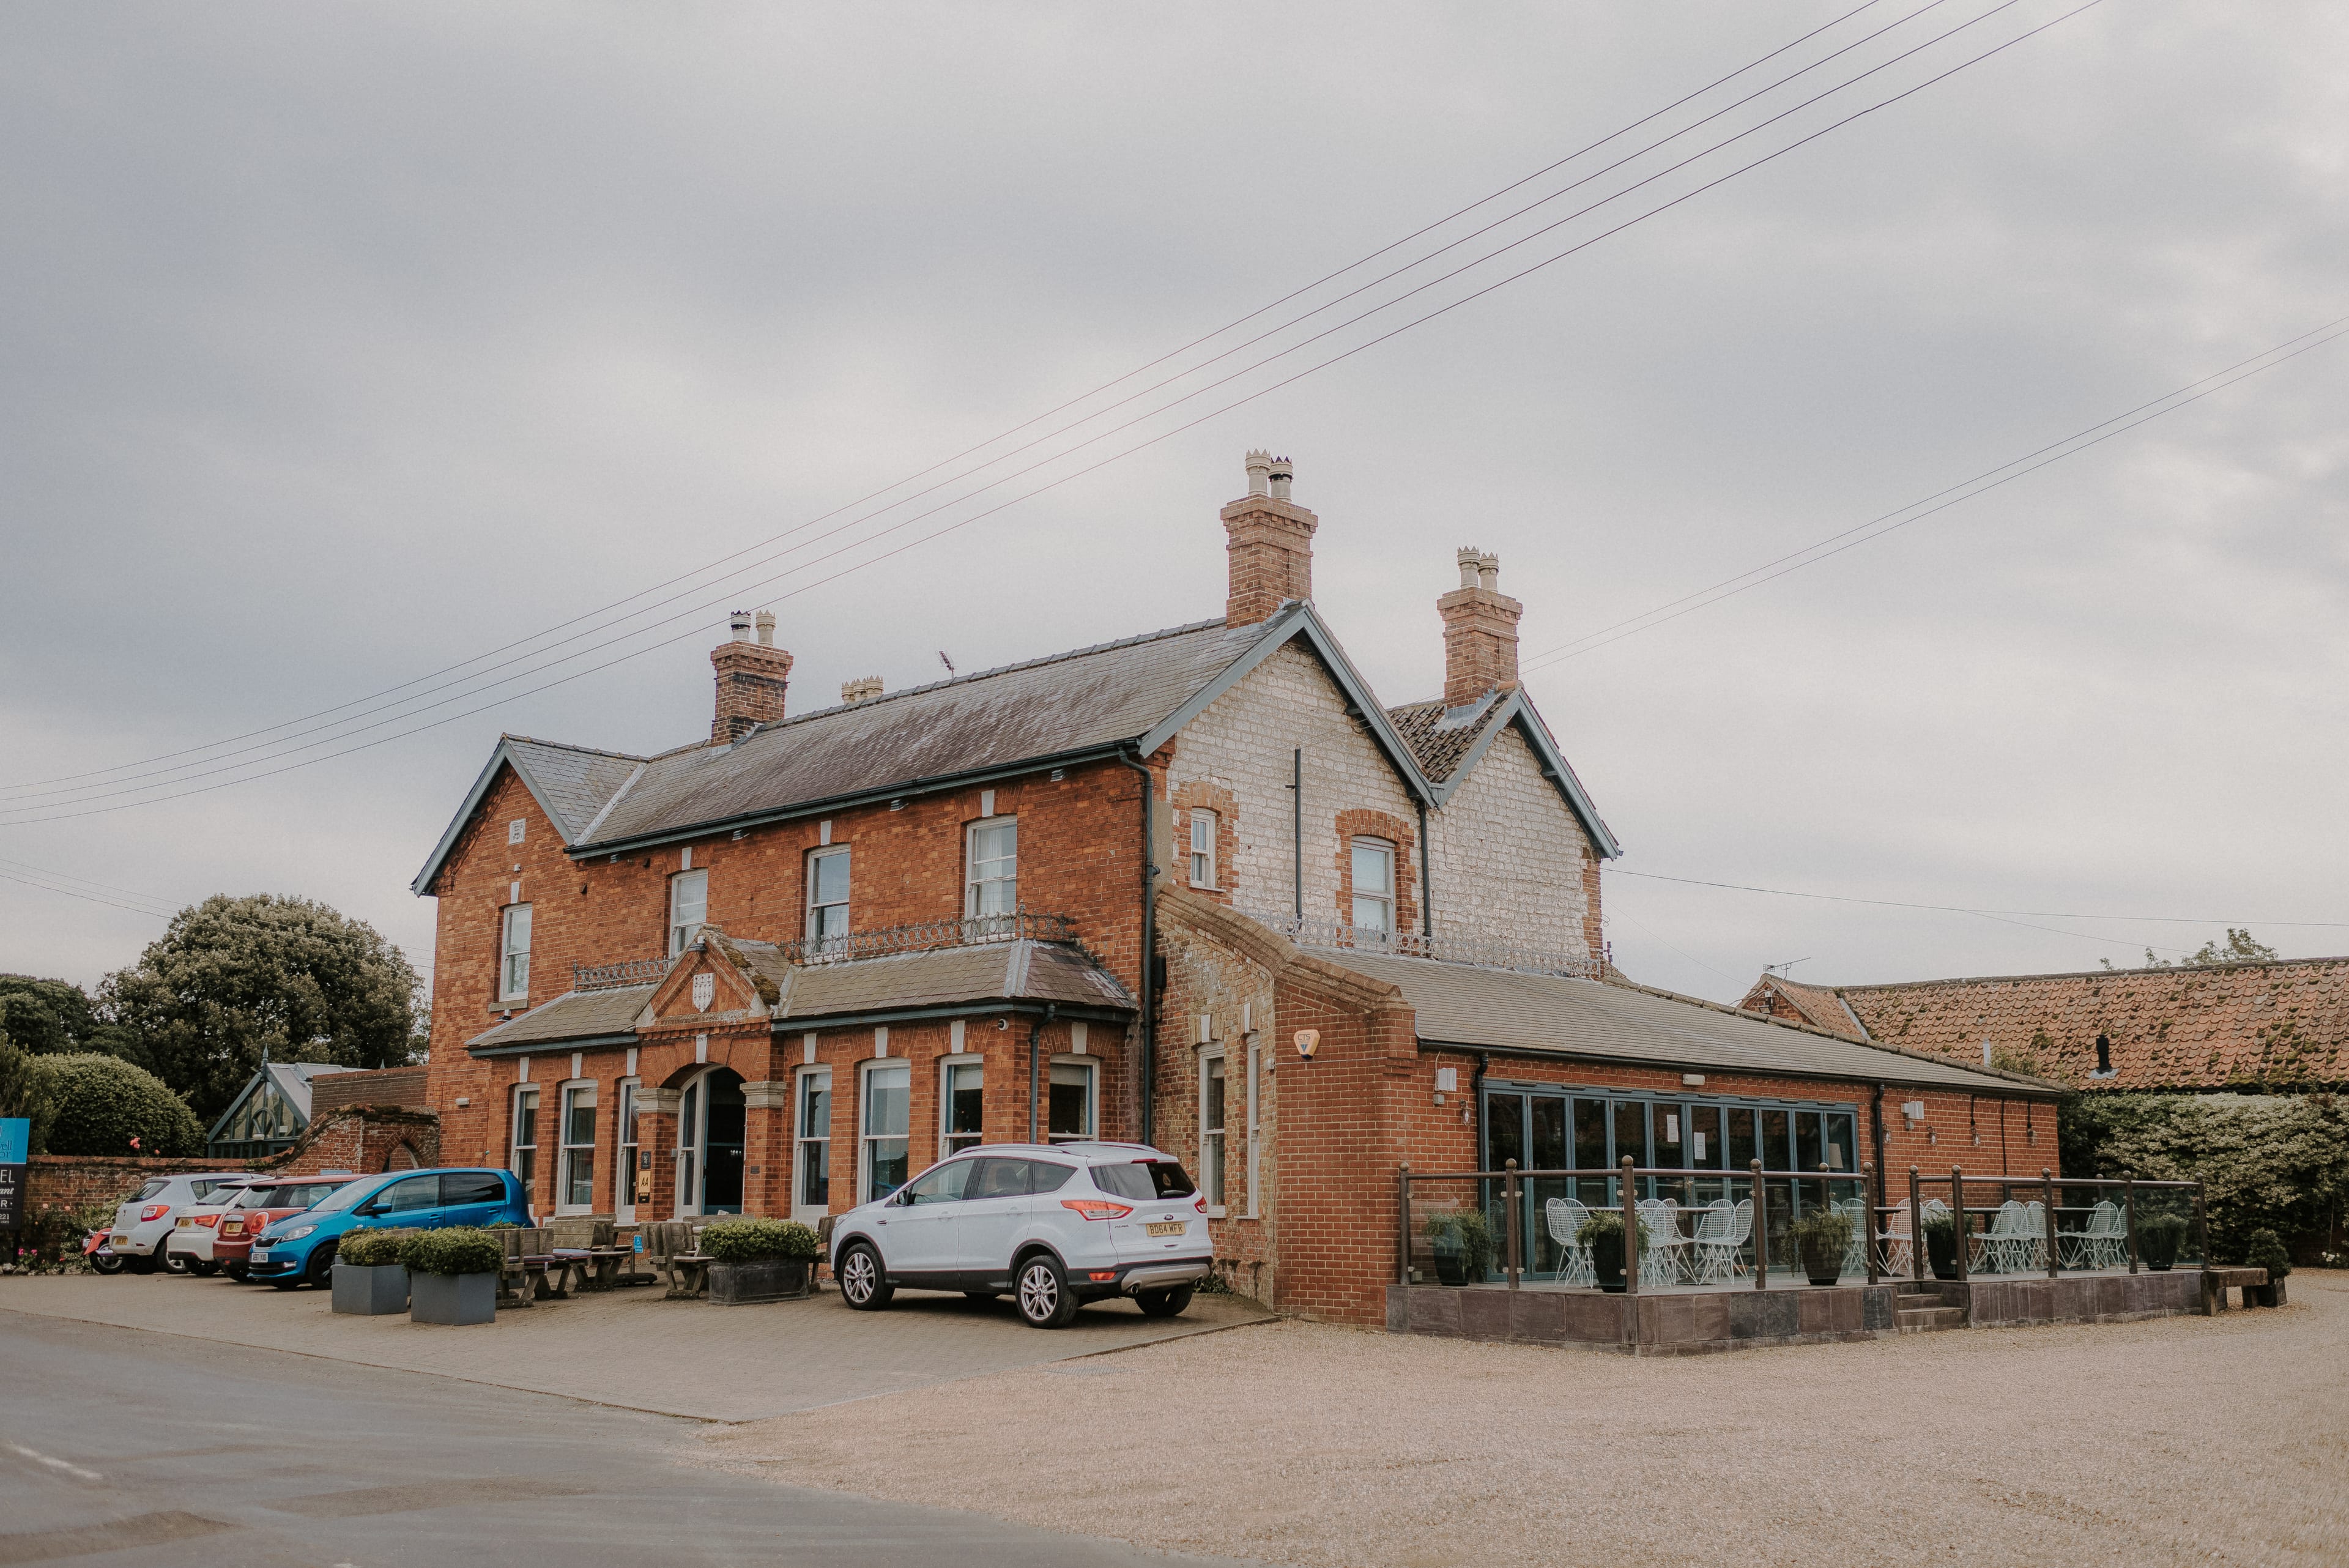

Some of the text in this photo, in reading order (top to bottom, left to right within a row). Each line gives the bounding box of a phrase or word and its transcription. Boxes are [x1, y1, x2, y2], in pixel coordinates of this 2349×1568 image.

[640, 1176, 648, 1187] AA
[1149, 1223, 1182, 1235] BD64 WFR
